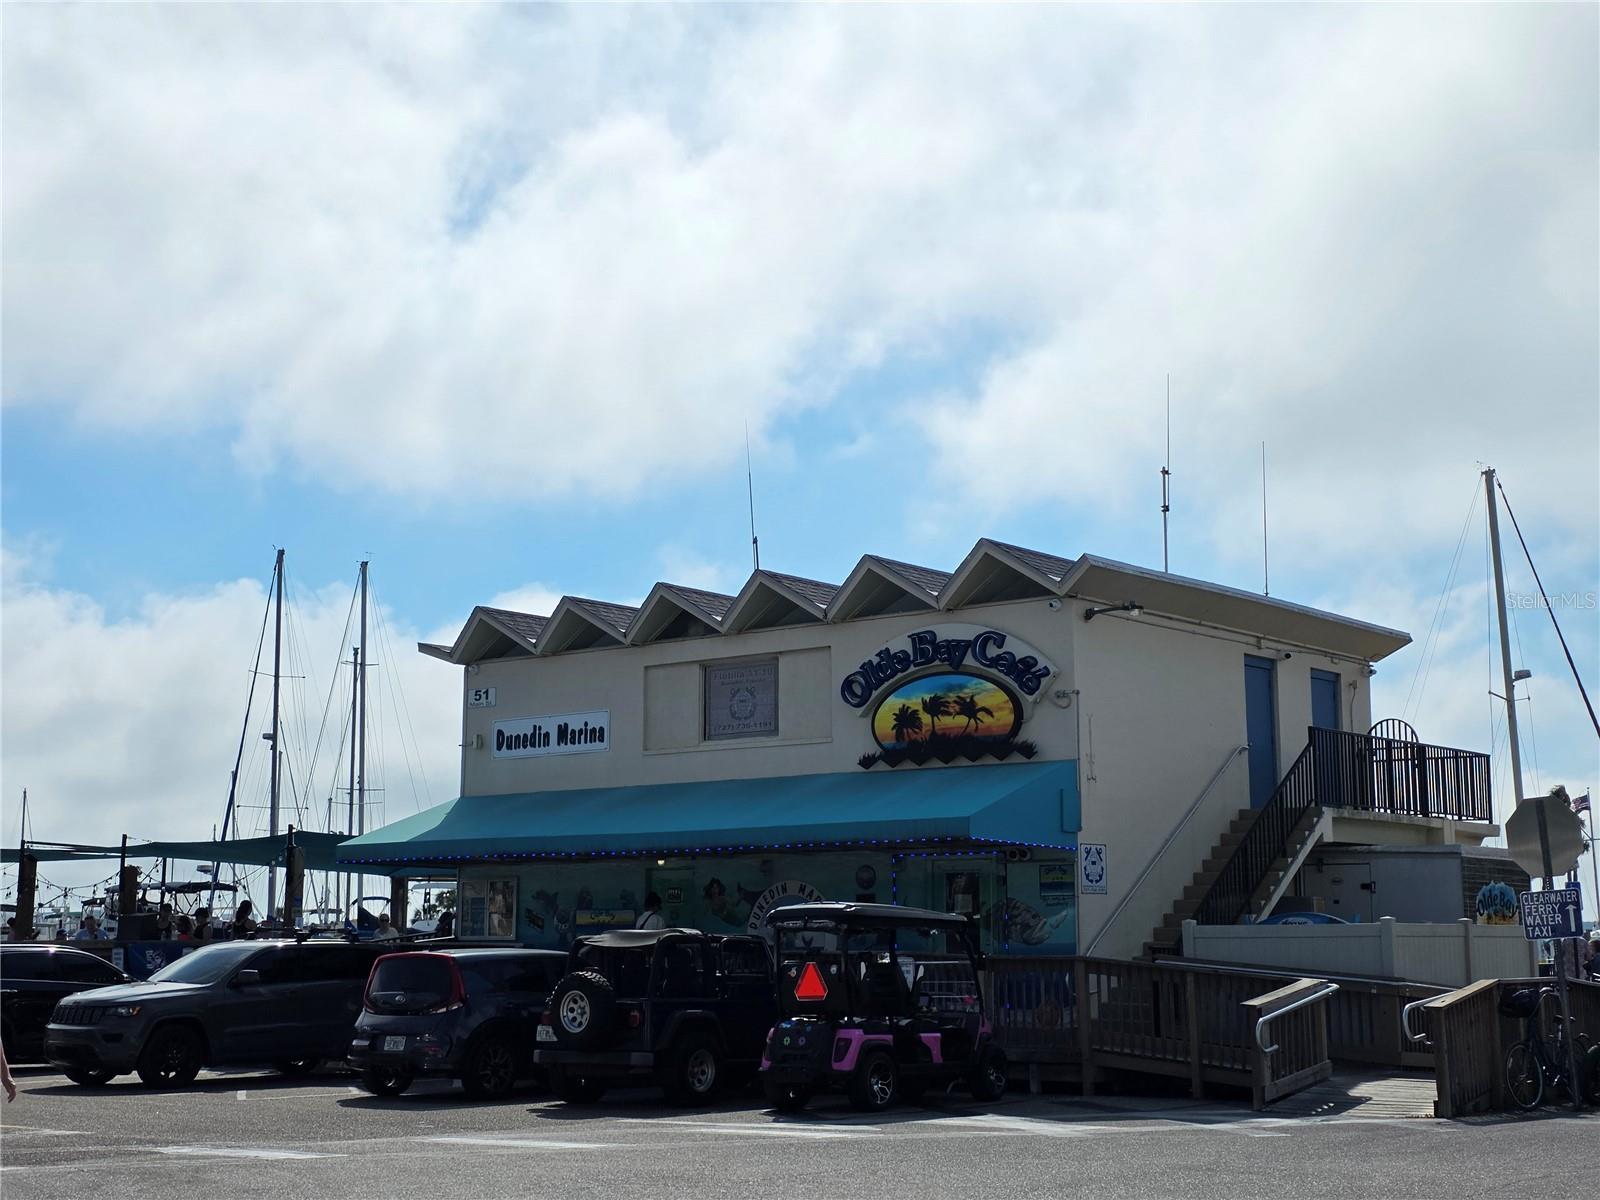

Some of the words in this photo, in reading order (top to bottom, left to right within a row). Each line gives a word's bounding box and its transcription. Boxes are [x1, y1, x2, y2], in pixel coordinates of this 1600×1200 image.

[840, 647, 911, 708] Olde
[908, 630, 972, 670] Bay
[474, 689, 489, 701] 51
[496, 724, 550, 752] Dunedin
[557, 721, 605, 746] Marina
[1476, 888, 1499, 917] Olde
[1522, 890, 1578, 905] CLEARWATER
[749, 882, 788, 930] DUNEDIN
[1524, 903, 1560, 916] FERRY
[1525, 913, 1562, 926] WATER
[1527, 925, 1552, 938] TAXI
